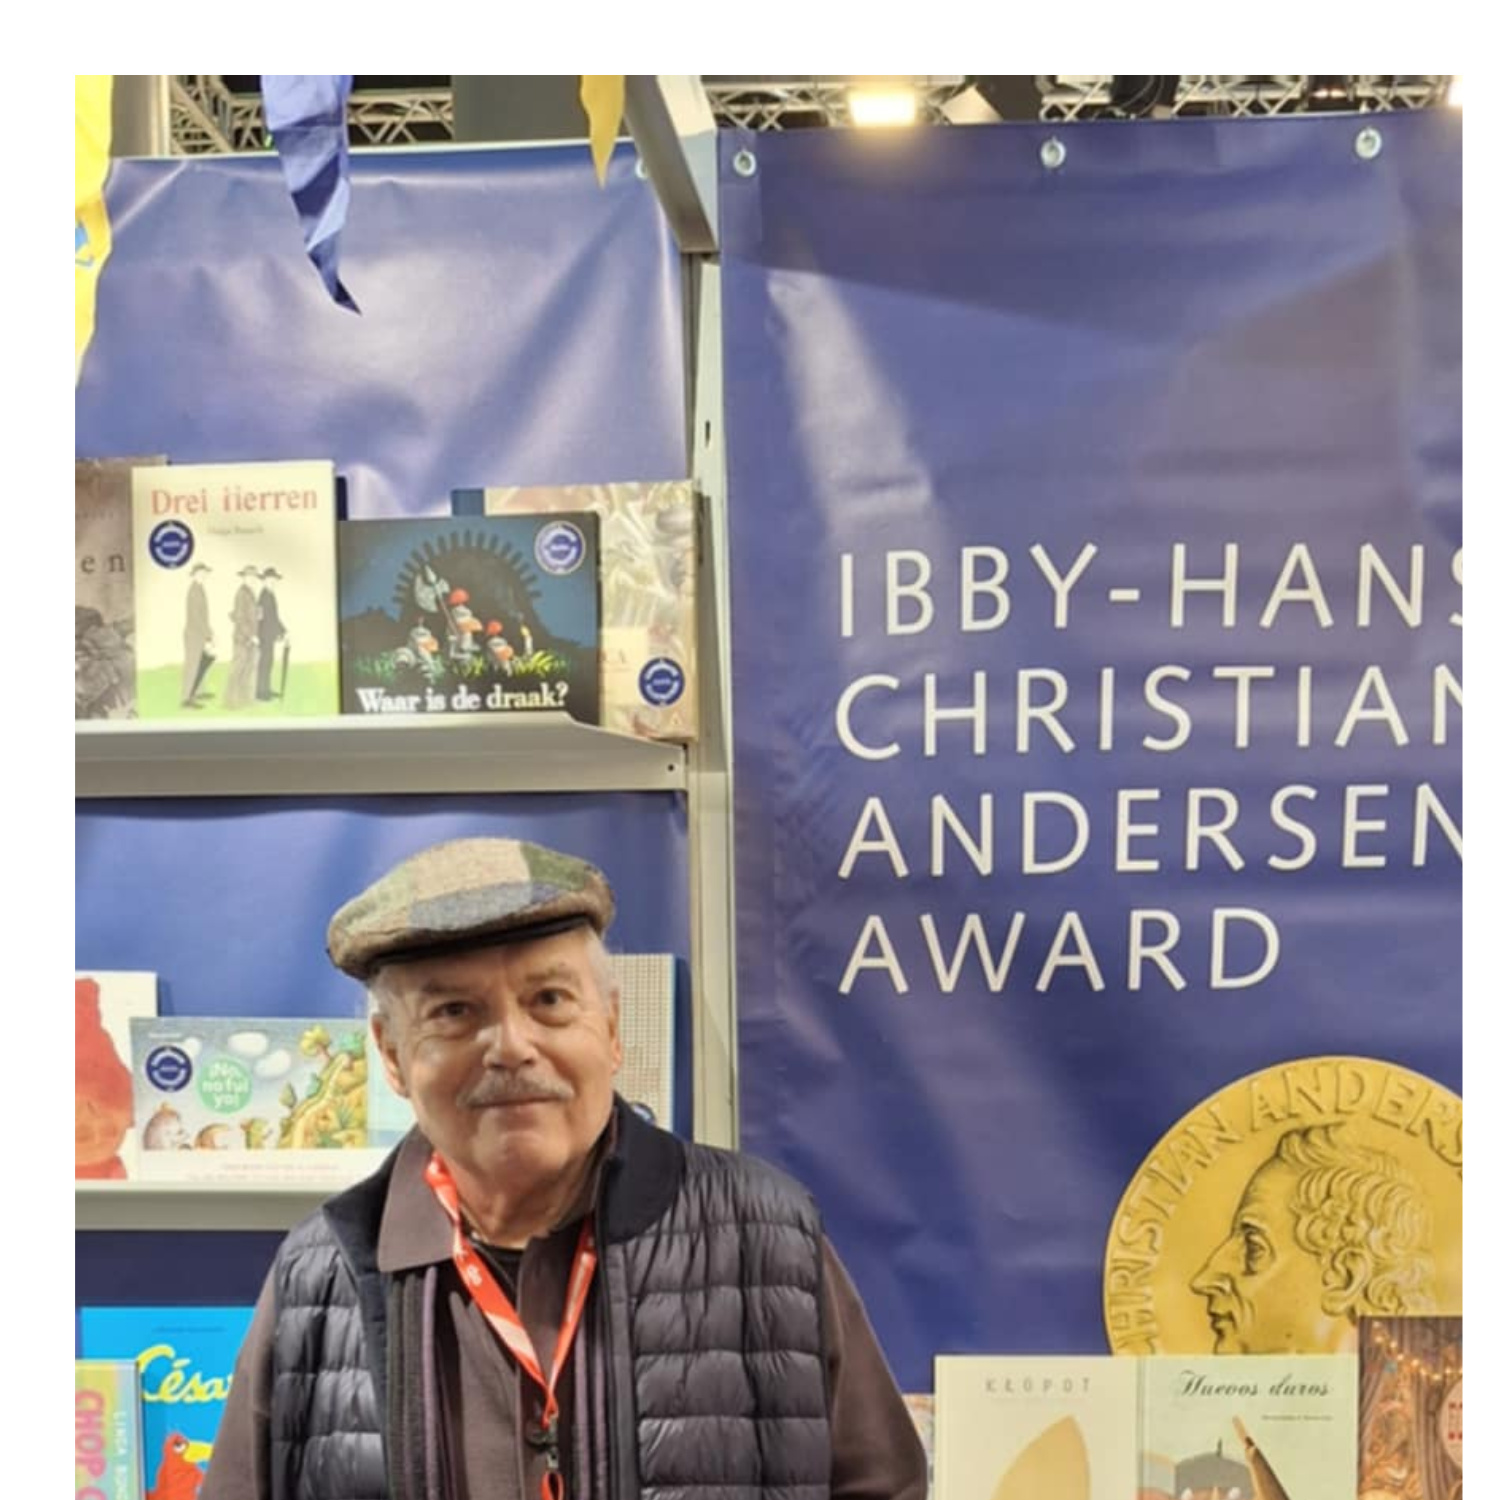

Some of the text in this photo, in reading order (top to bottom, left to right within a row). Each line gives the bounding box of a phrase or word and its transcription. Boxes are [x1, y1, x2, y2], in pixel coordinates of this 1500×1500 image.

[151, 485, 318, 515] Drei Herren
[840, 542, 1463, 638] IBBY-HAN
[356, 680, 570, 712] Waar is de draak?
[837, 782, 1463, 878] ANDERSEN
[837, 906, 1280, 995] AWARD
[1108, 1062, 1463, 1356] HRISTIAN ANDER
[136, 1344, 234, 1403] Césa
[1178, 1369, 1331, 1397] Huevos duros
[75, 1389, 108, 1478] CHOP
